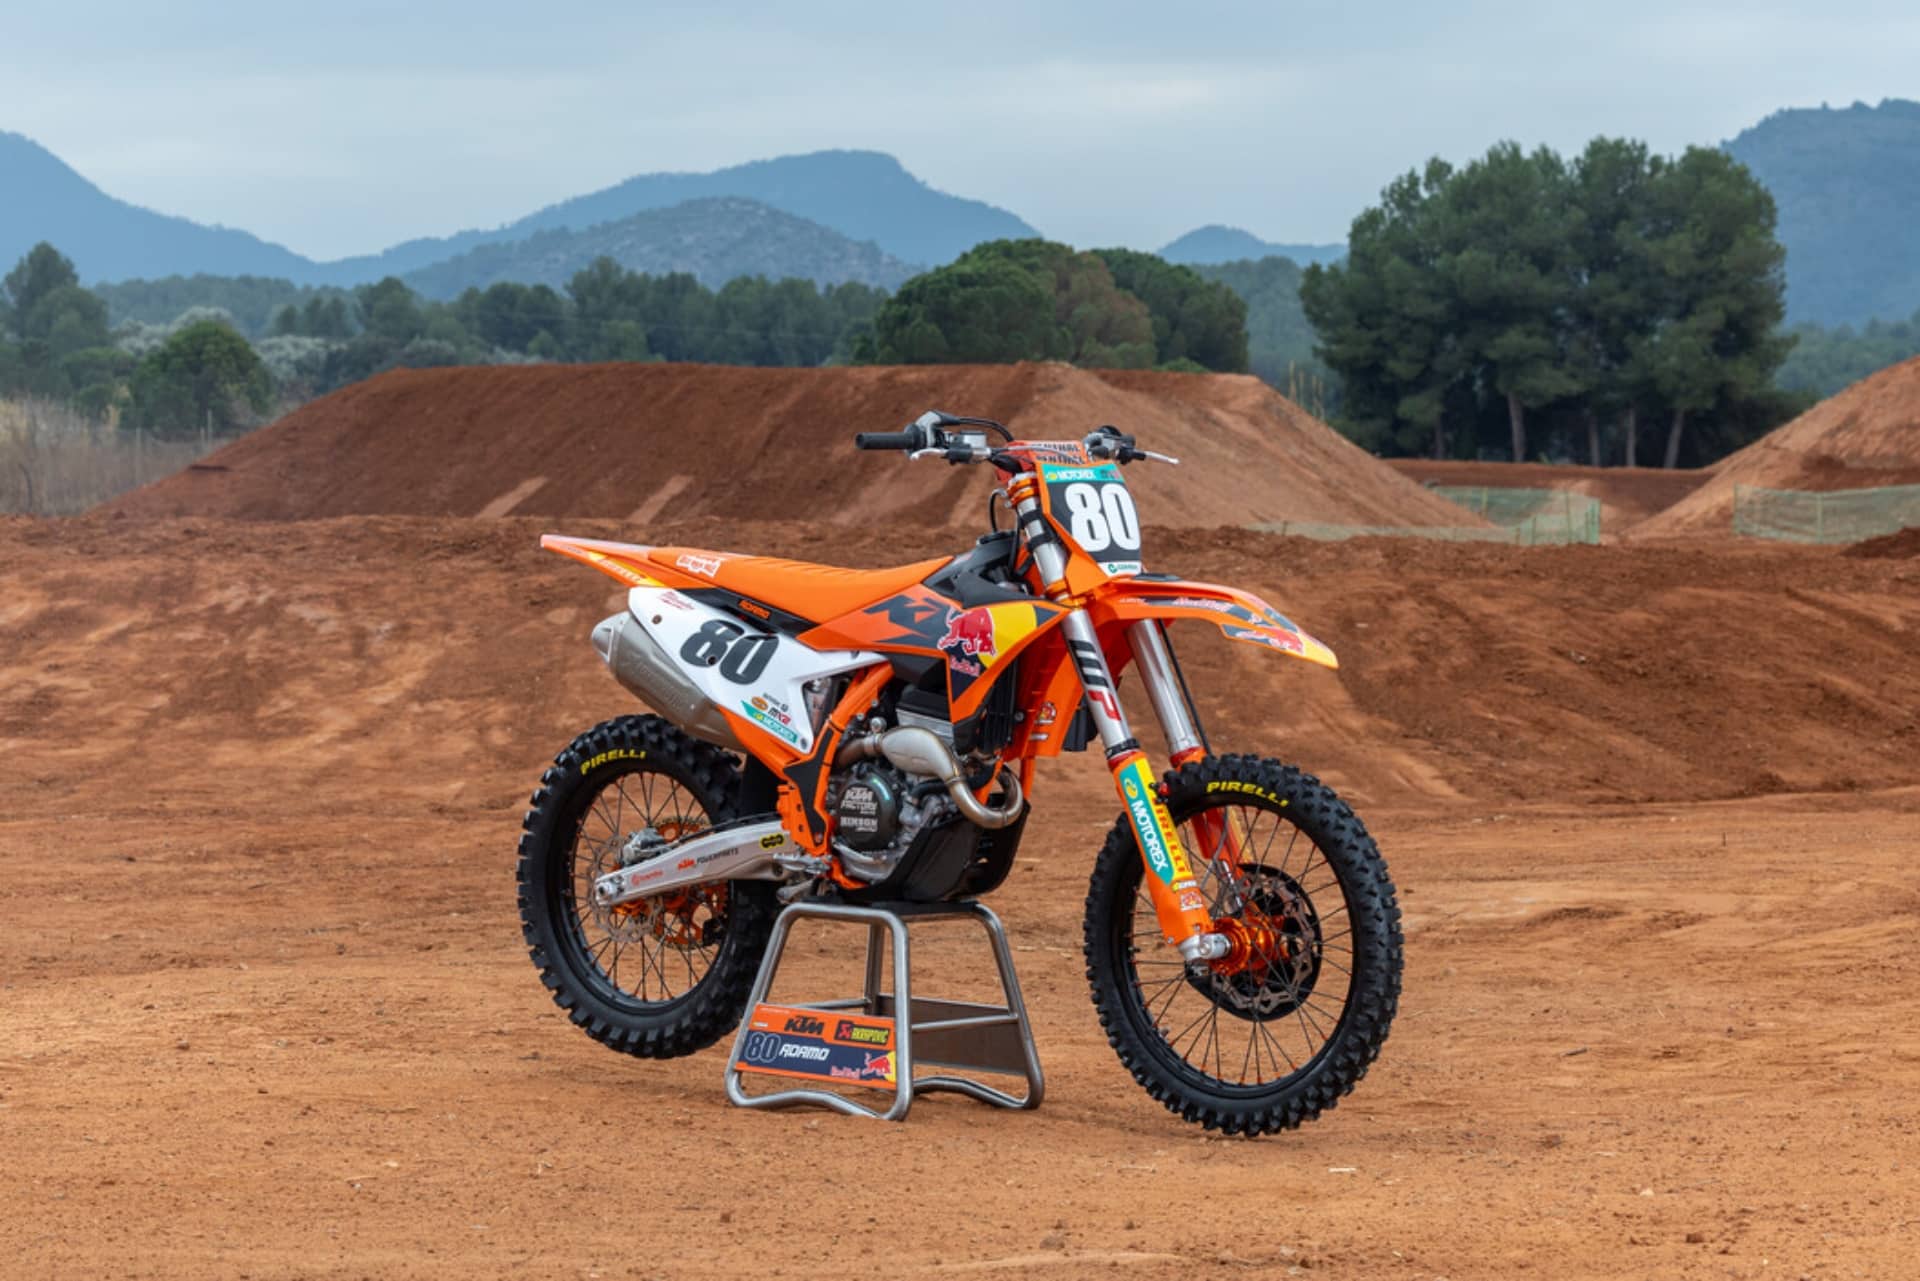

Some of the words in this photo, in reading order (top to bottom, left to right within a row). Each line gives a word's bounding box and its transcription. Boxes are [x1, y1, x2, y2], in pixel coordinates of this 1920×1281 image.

[1057, 470, 1095, 480] MOTOREX
[1064, 482, 1141, 553] 80
[679, 618, 780, 686] 80
[580, 748, 647, 775] PIRELLI
[840, 800, 878, 810] FACTORY
[1205, 780, 1289, 807] PIRELLI
[1130, 799, 1169, 873] MOTOREX
[784, 1014, 825, 1036] KTM
[745, 1031, 782, 1063] 80
[779, 1043, 831, 1061] ADAMO
